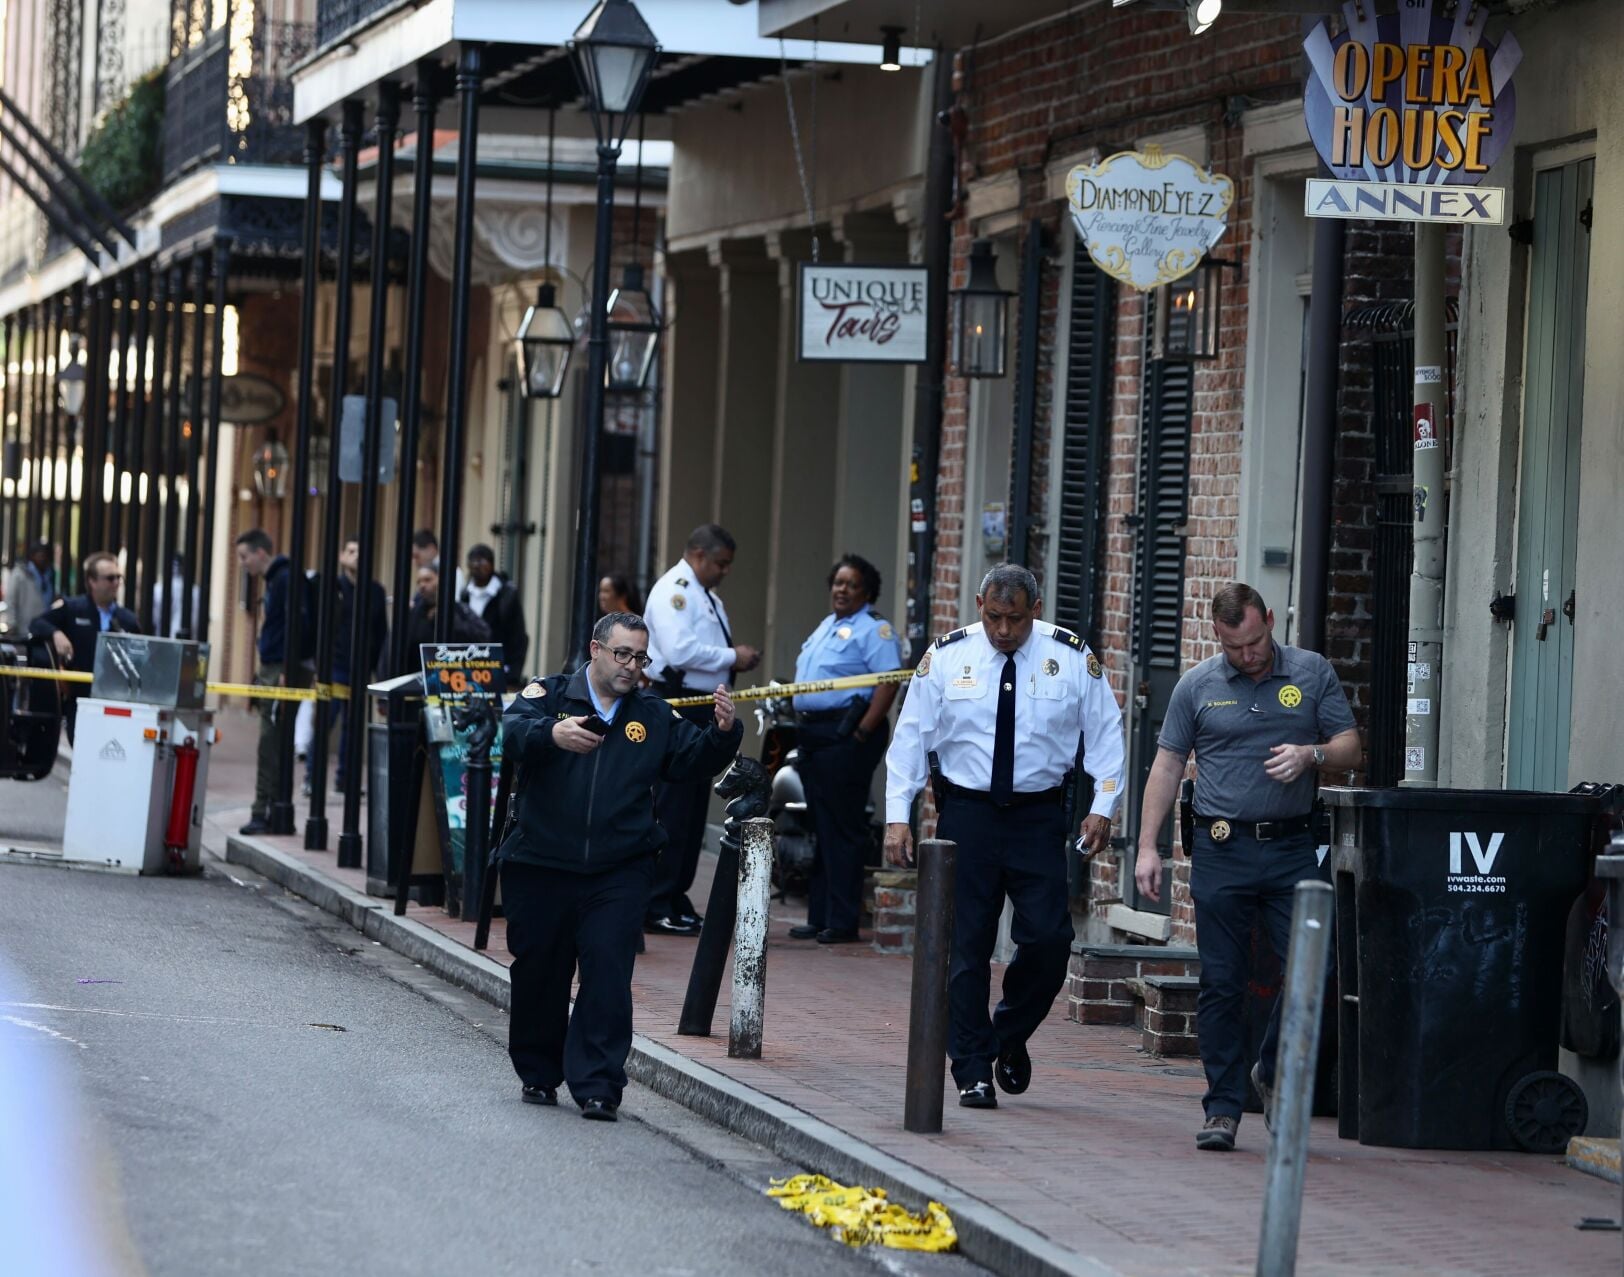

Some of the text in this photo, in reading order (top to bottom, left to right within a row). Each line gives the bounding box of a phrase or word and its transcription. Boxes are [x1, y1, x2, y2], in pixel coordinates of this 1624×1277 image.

[1333, 40, 1494, 107] OPERA
[1332, 106, 1493, 173] HOUSE
[1315, 185, 1492, 219] ANNEX
[1165, 216, 1211, 247] Jewelry
[1124, 236, 1165, 268] Gallery
[812, 276, 924, 304] UNIQUE
[794, 681, 833, 694] POLICE
[1449, 831, 1505, 874] IV
[1447, 884, 1506, 893] 504.224.6670
